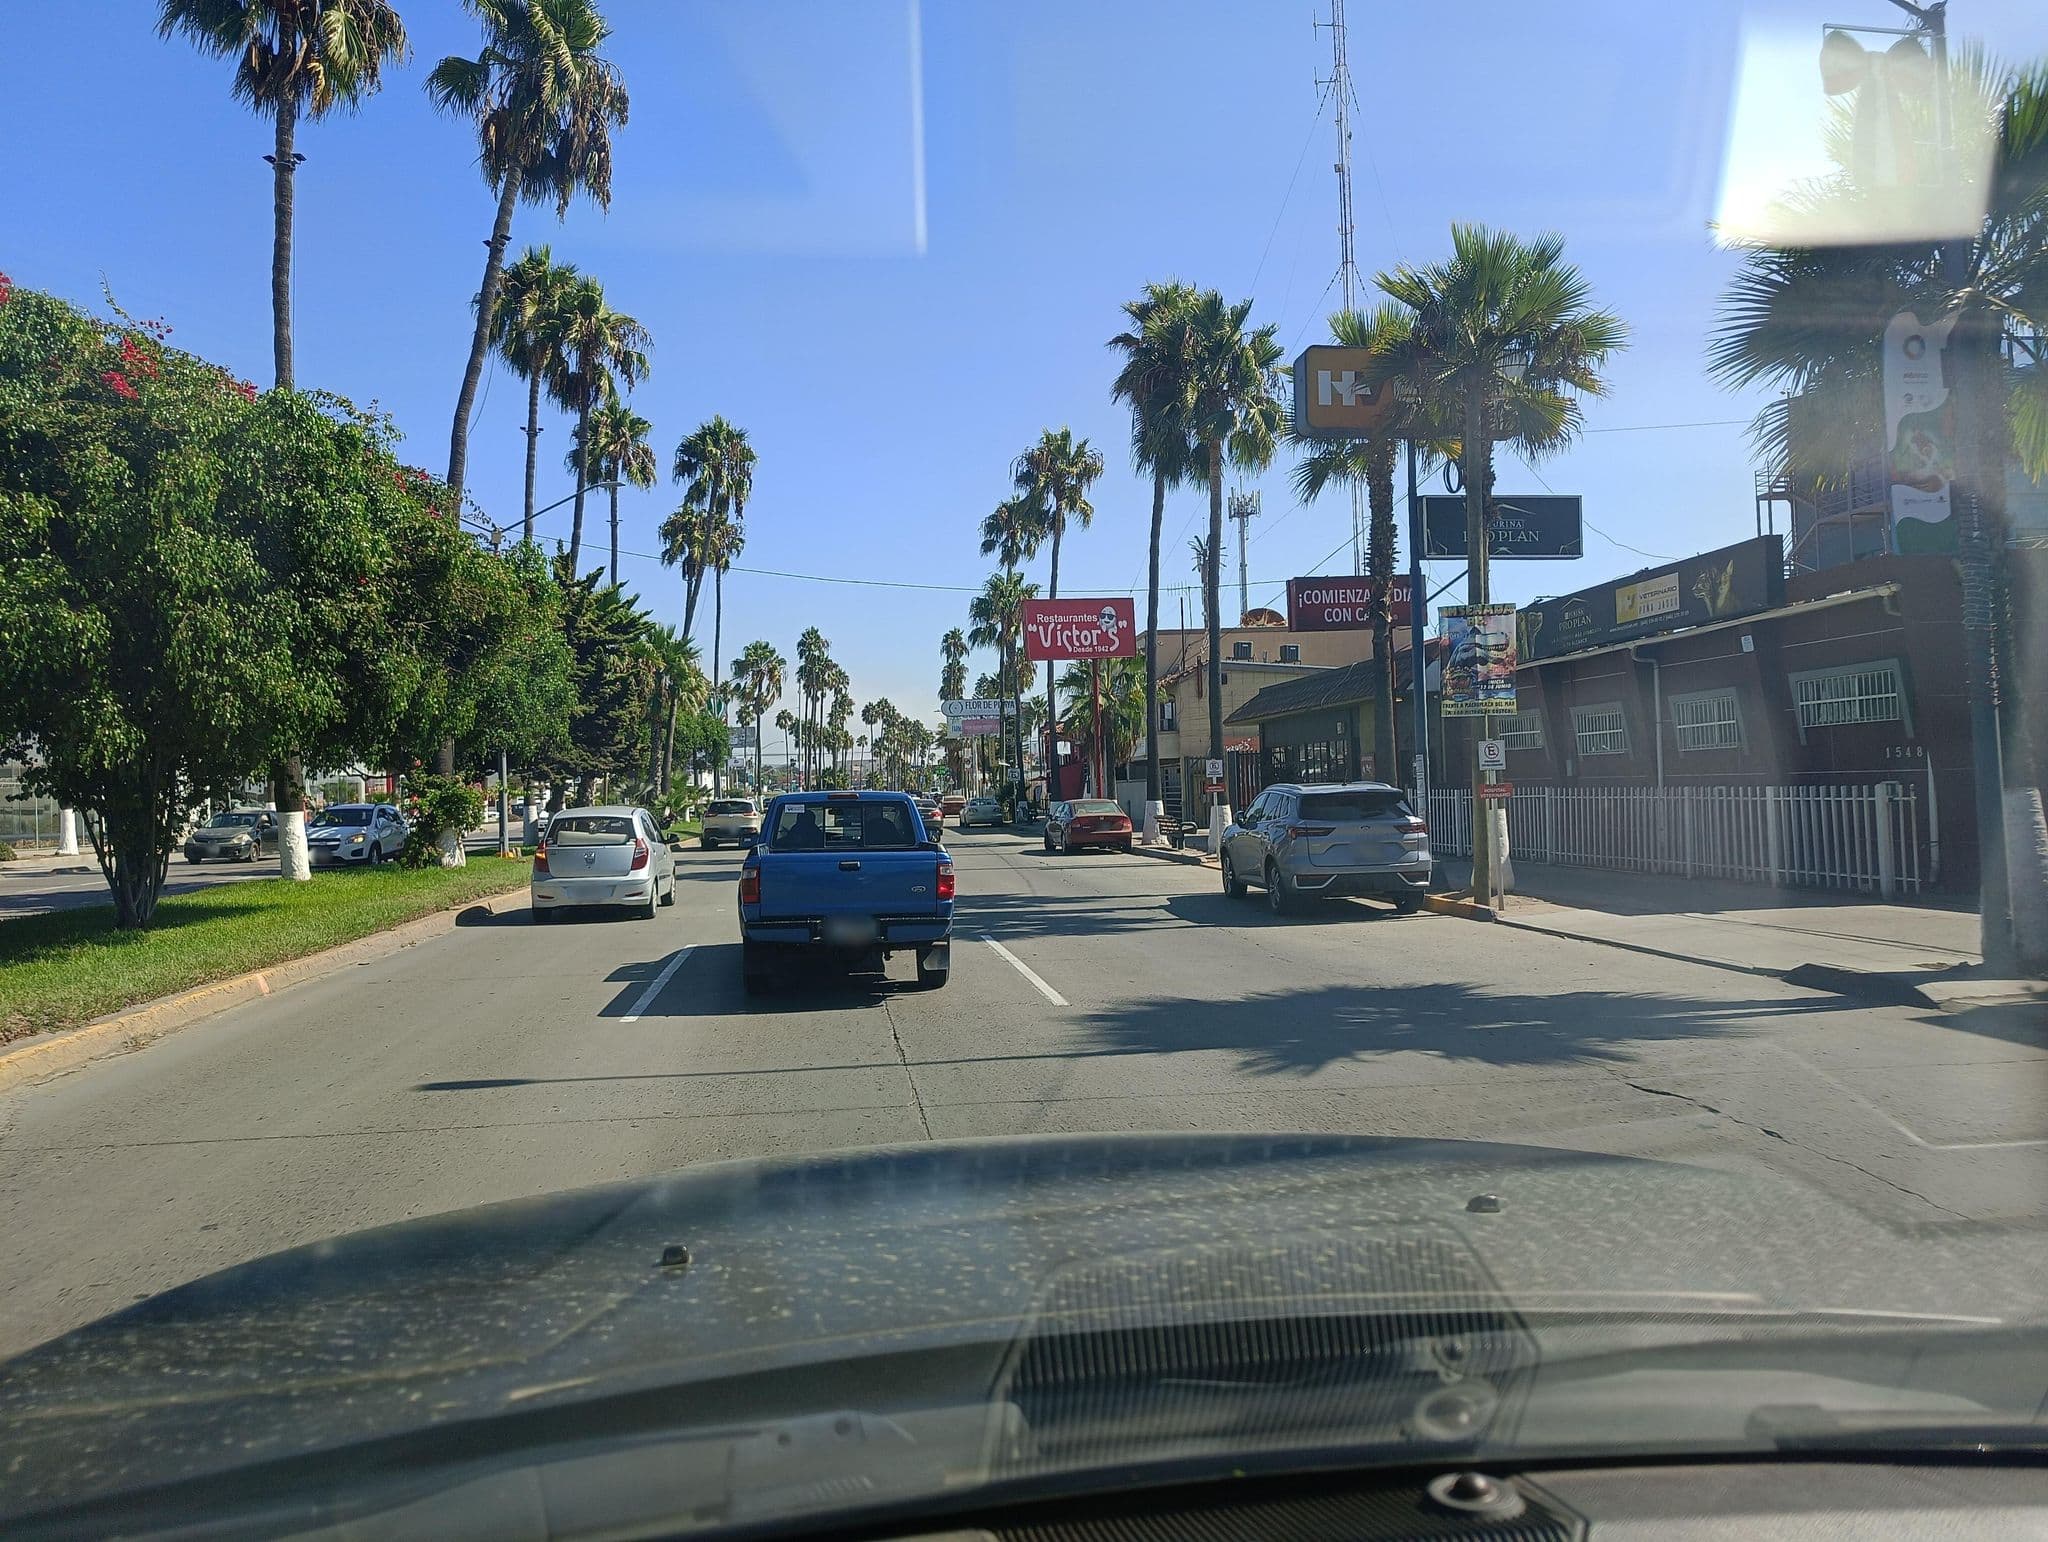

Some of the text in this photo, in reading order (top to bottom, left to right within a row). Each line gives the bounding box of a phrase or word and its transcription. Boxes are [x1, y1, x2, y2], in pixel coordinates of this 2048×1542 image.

[1490, 520, 1522, 528] URINA
[1499, 530, 1539, 542] PLAN
[1036, 613, 1098, 623] Restaurantes
[1324, 608, 1352, 622] CON
[965, 701, 982, 710] FLOR
[984, 701, 993, 709] DE
[1886, 746, 1923, 758] 1548
